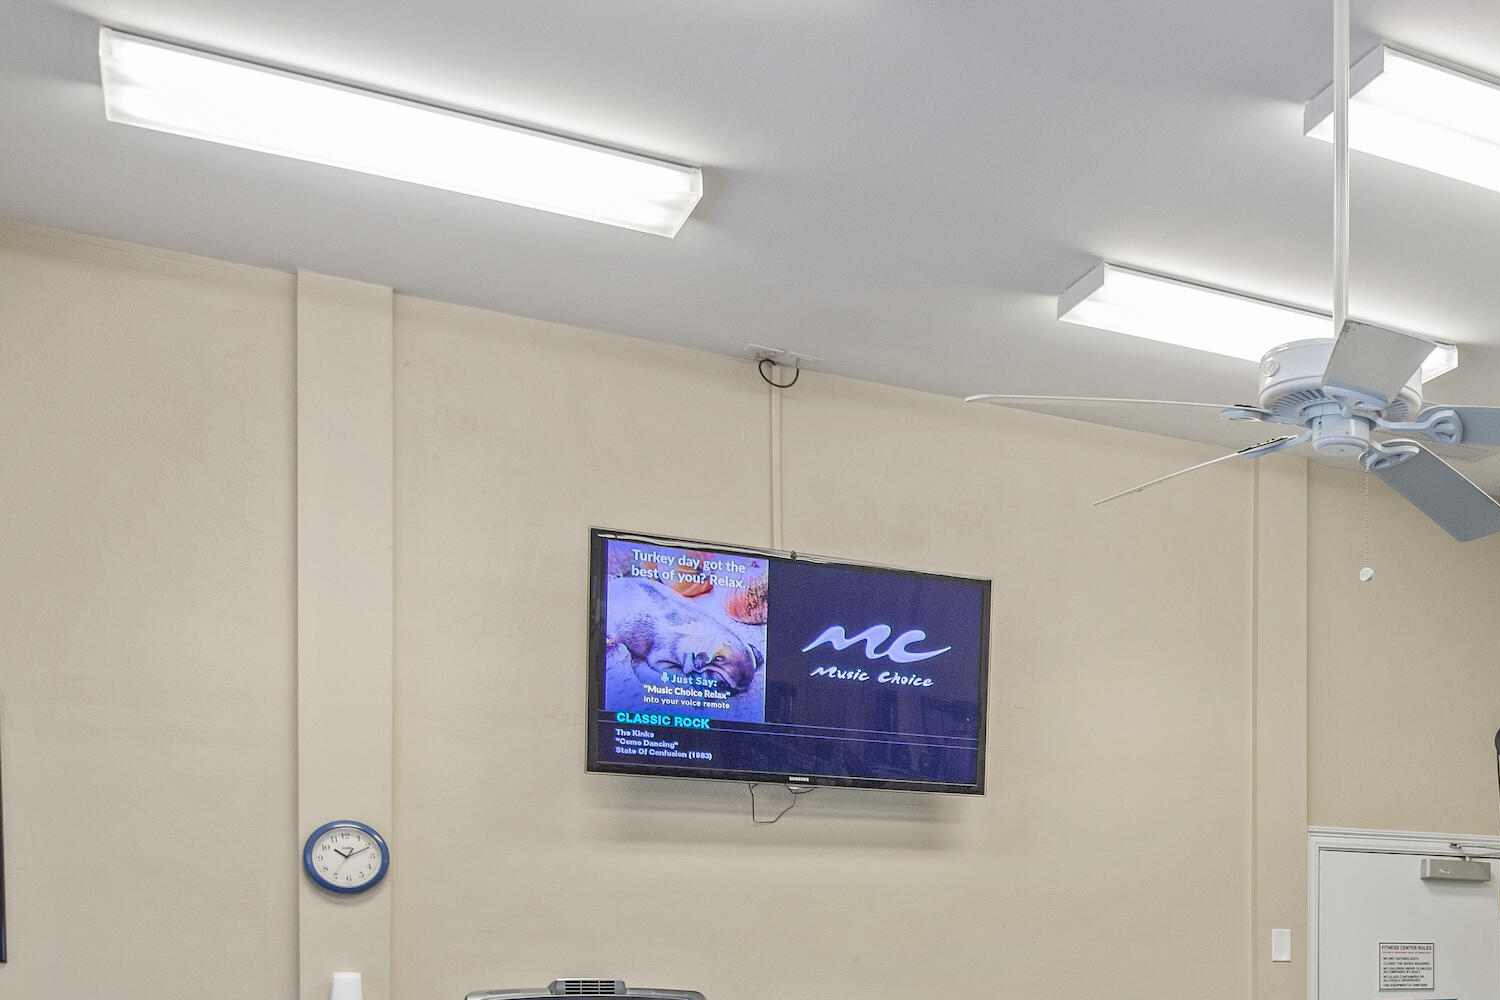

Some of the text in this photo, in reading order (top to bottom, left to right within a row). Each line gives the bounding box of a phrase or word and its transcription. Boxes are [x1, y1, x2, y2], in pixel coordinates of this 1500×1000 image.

[632, 549, 746, 573] Turkey day got the
[631, 565, 746, 589] best of you? Relax.
[671, 674, 718, 688] Just Say:
[810, 666, 934, 687] Music Choice
[643, 684, 731, 700] "Music Choice Relax"
[643, 696, 659, 704] into
[661, 698, 679, 706] your
[703, 702, 730, 710] remote
[616, 712, 711, 729] CLASSIC ROCK
[632, 730, 655, 738] Kinks
[615, 737, 679, 749] "Come Dancing"
[615, 747, 637, 755] State
[649, 750, 687, 759] Confusion
[689, 751, 713, 761] (1983)
